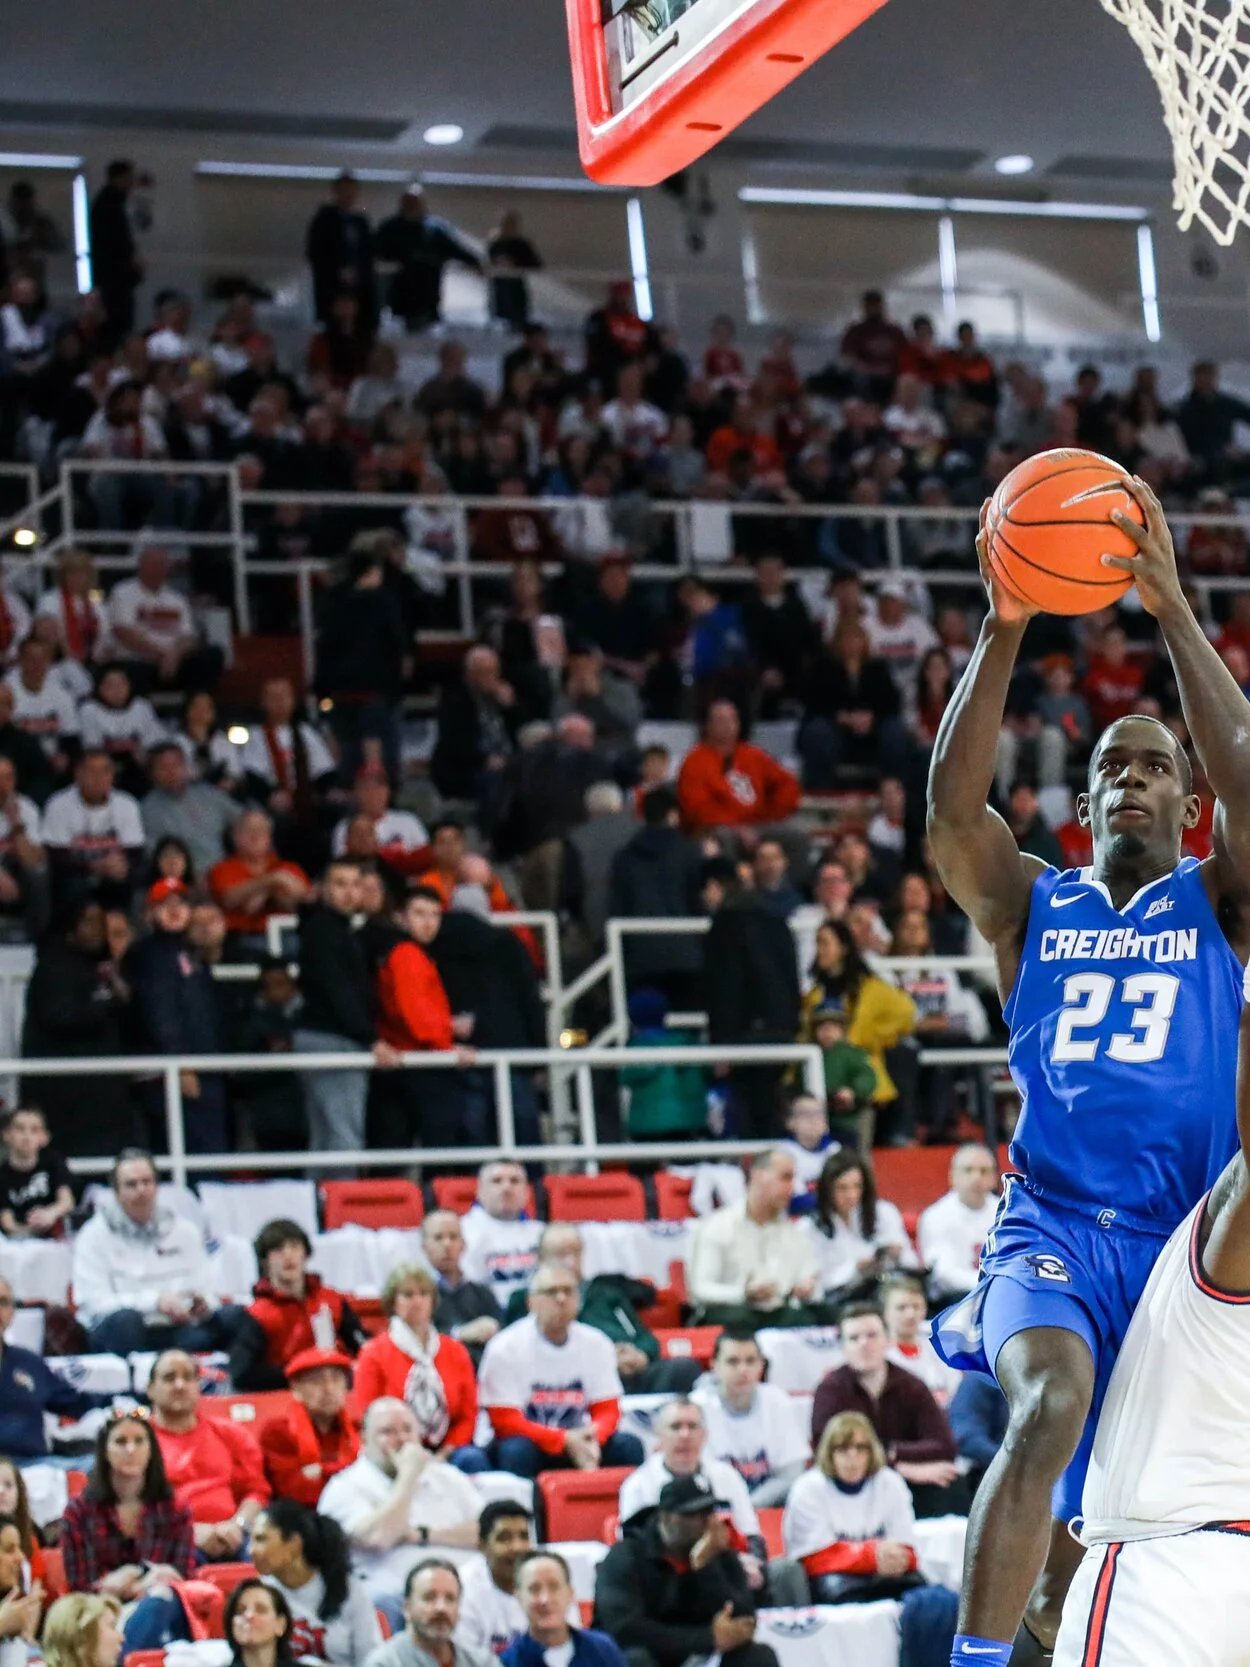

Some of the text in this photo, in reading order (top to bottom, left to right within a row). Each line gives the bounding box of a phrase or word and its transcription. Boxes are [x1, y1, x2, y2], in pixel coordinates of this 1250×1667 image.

[1040, 927, 1198, 963] CREIGHTON
[1051, 971, 1180, 1064] 23
[1096, 1208, 1117, 1229] C
